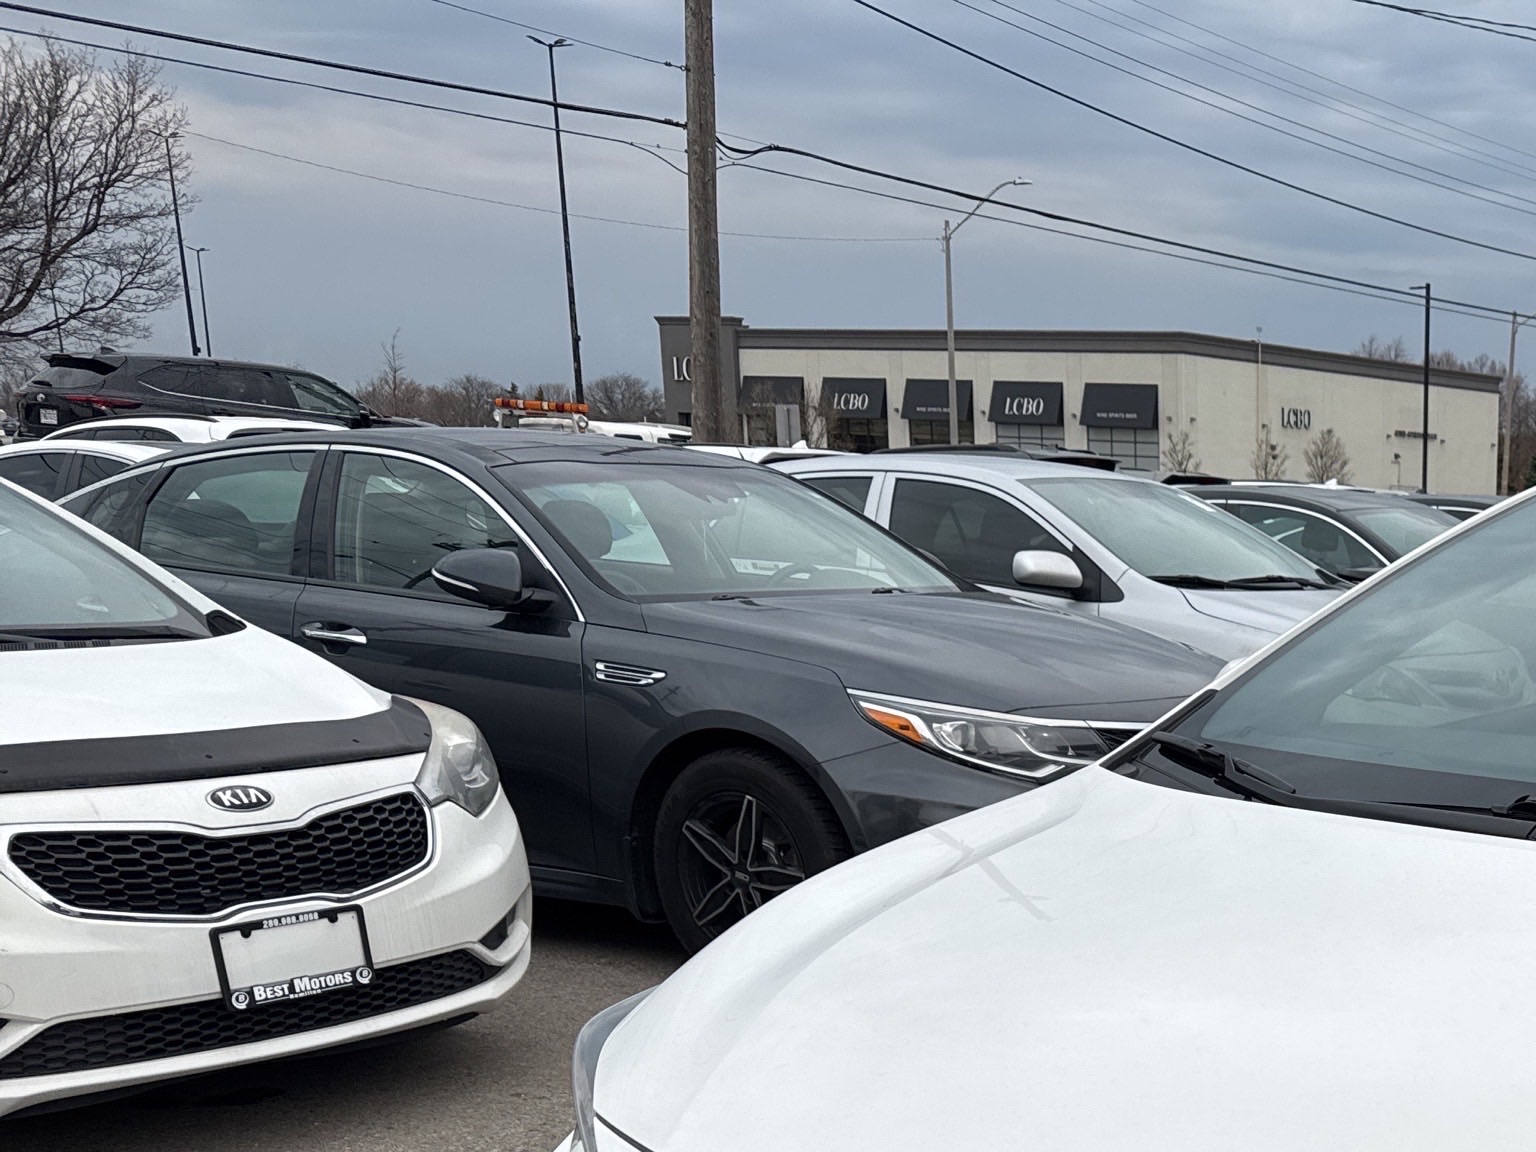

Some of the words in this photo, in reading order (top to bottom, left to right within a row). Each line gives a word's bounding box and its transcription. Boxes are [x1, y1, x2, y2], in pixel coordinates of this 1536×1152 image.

[672, 356, 692, 381] LC
[833, 392, 869, 411] LCBO
[1004, 396, 1044, 416] LCBO
[1281, 407, 1311, 430] LCBO
[215, 787, 268, 807] KIA
[253, 983, 290, 1002] BEST
[293, 970, 353, 995] MOTORS
